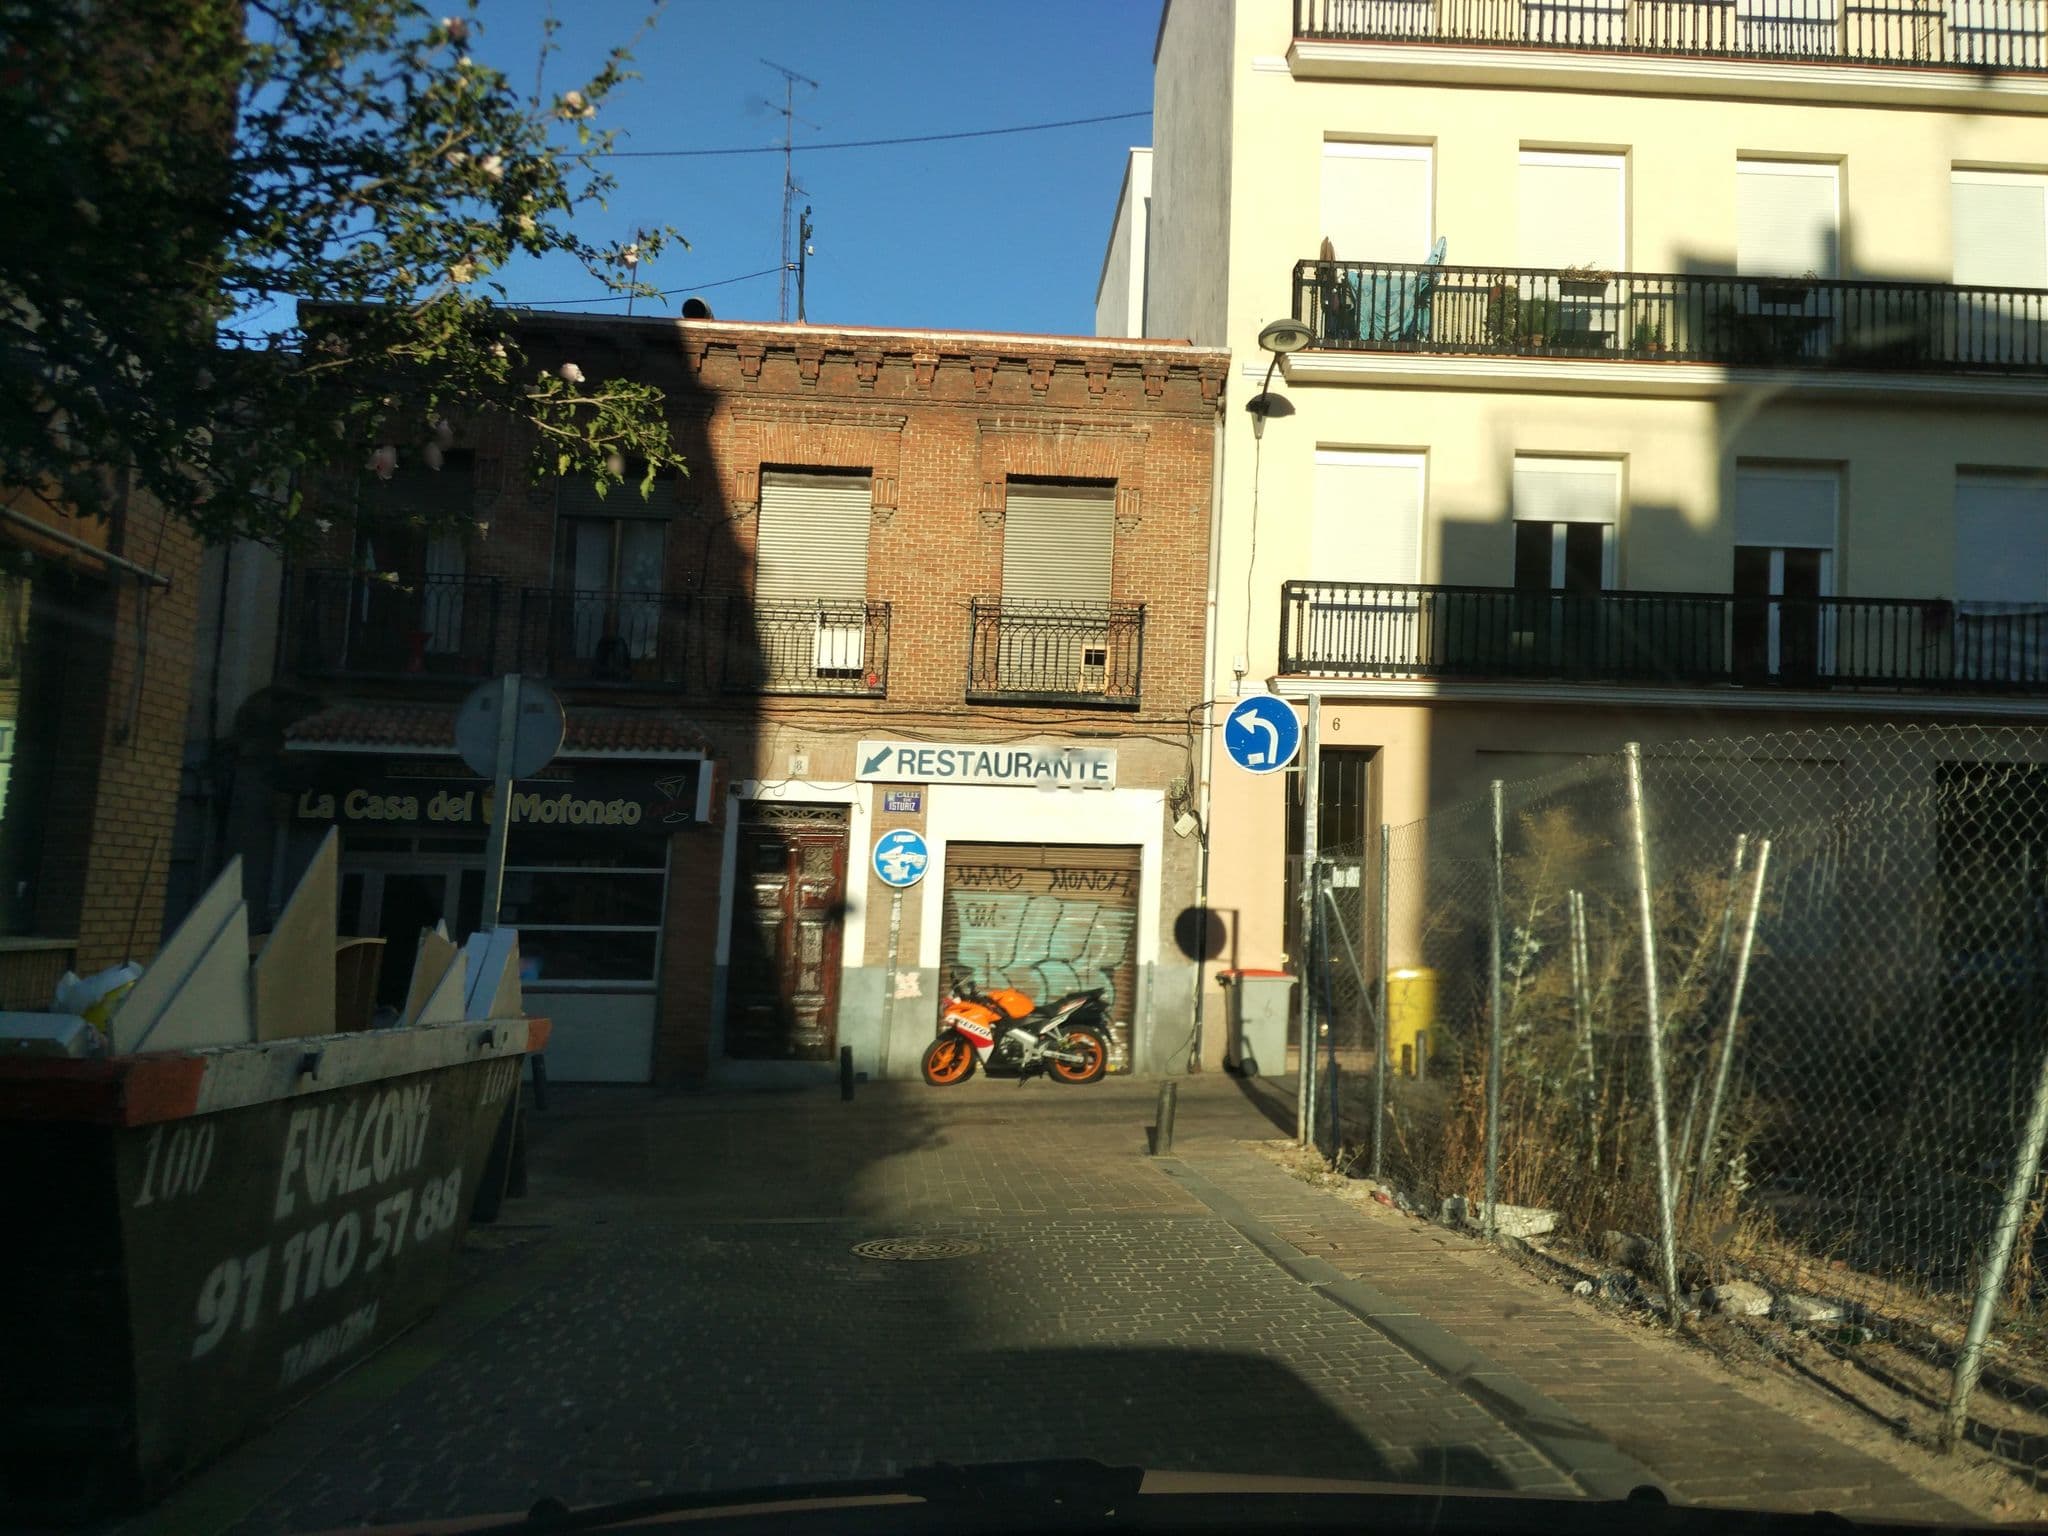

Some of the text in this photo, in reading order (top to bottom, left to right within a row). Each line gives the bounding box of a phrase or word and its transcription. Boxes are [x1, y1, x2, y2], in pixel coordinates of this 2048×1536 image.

[1331, 717, 1341, 731] 6
[898, 747, 1109, 781] RESTAURANTE
[298, 789, 336, 820] La
[344, 789, 419, 821] Casa
[427, 790, 476, 823] del
[510, 792, 643, 827] Mofongo
[133, 1123, 216, 1209] 100
[191, 1245, 270, 1361] 91
[279, 1210, 361, 1314] 110
[364, 1189, 414, 1273] 57
[415, 1167, 464, 1243] 88
